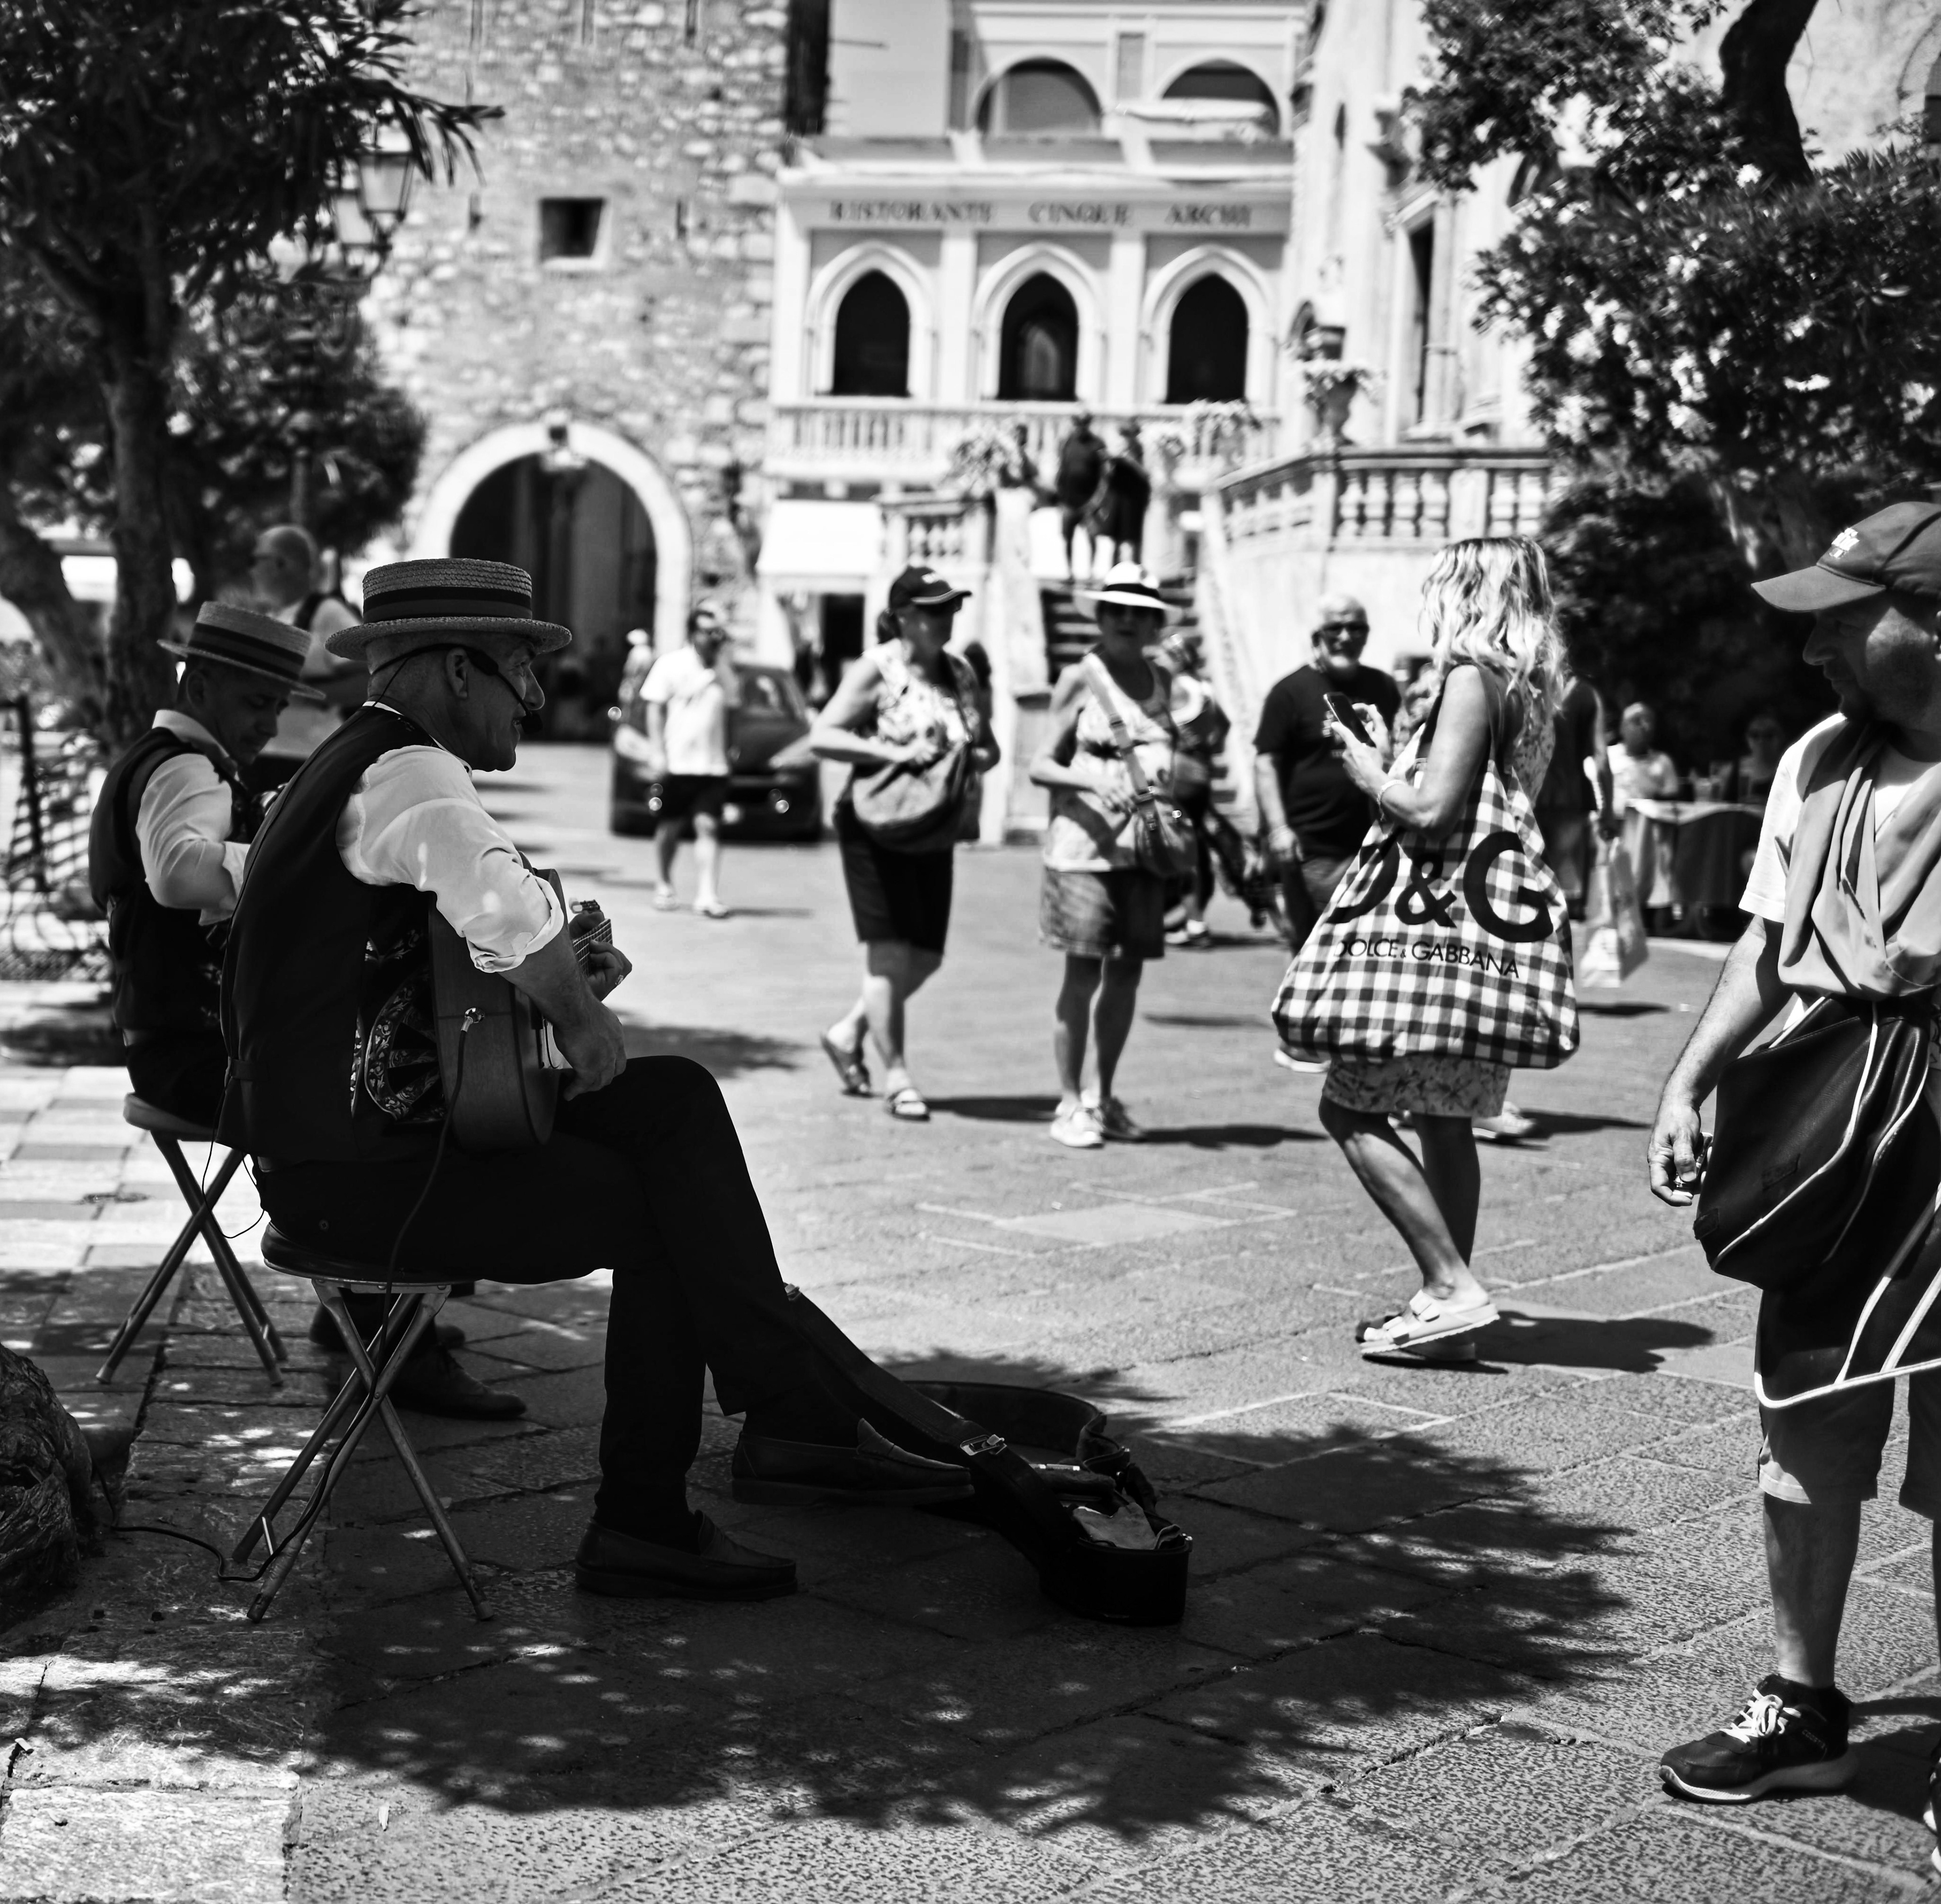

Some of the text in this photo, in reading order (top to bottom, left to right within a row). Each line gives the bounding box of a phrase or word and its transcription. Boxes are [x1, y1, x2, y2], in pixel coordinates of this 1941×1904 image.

[829, 200, 1253, 227] RISTORANTE CINQUE ARCHI
[1411, 941, 1519, 979] GABBANA
